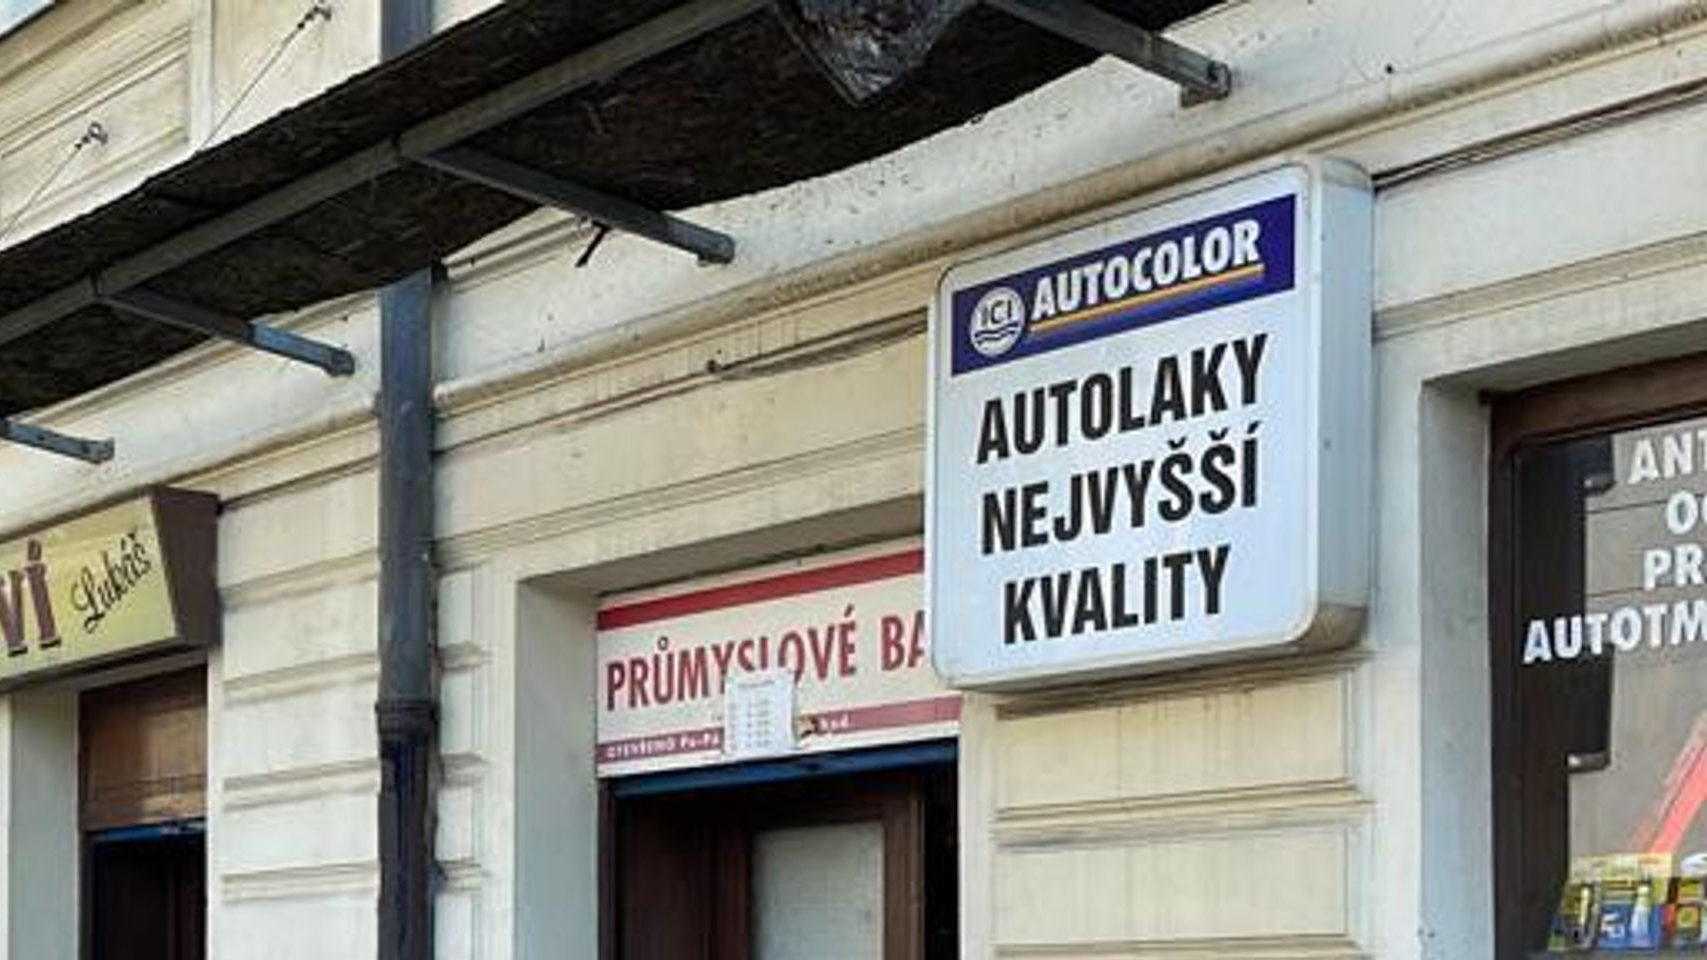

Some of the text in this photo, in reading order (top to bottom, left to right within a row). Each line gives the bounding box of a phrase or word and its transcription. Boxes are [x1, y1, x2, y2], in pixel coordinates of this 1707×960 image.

[1031, 219, 1261, 321] AUTOCOLOR
[976, 333, 1268, 465] AUTOLAKY
[981, 421, 1263, 556] NEJVYŠŠÍ
[1667, 490, 1707, 534] O
[71, 528, 152, 634] Lukáš
[1003, 544, 1232, 646] KVALITY
[1523, 600, 1707, 664] AUTOTM
